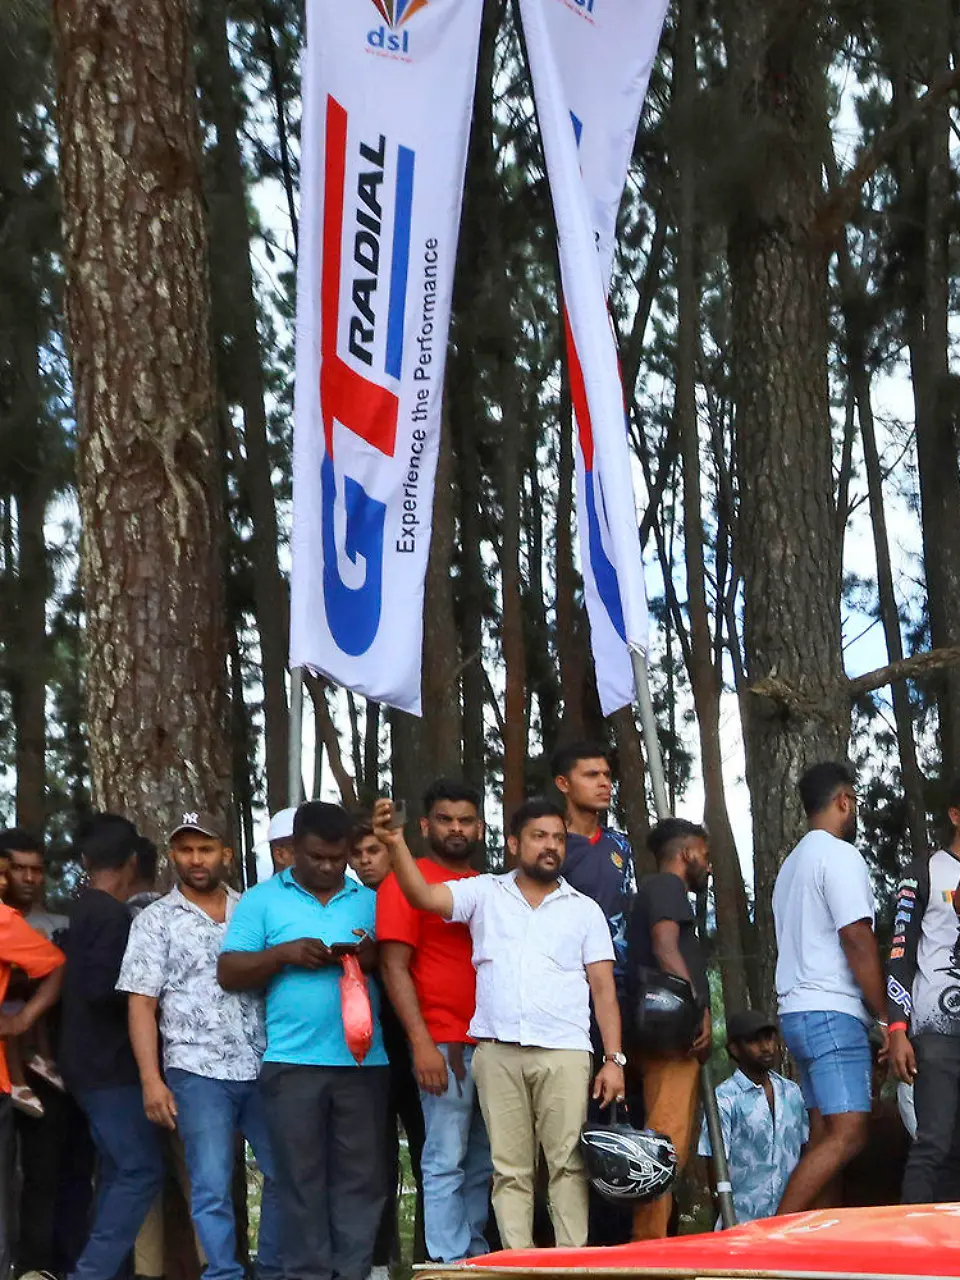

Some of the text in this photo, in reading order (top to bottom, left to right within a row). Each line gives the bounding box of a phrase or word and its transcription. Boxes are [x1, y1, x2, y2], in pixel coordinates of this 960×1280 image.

[367, 26, 408, 52] dsl
[349, 134, 386, 366] RADIAL
[396, 237, 439, 553] Experience the Performance
